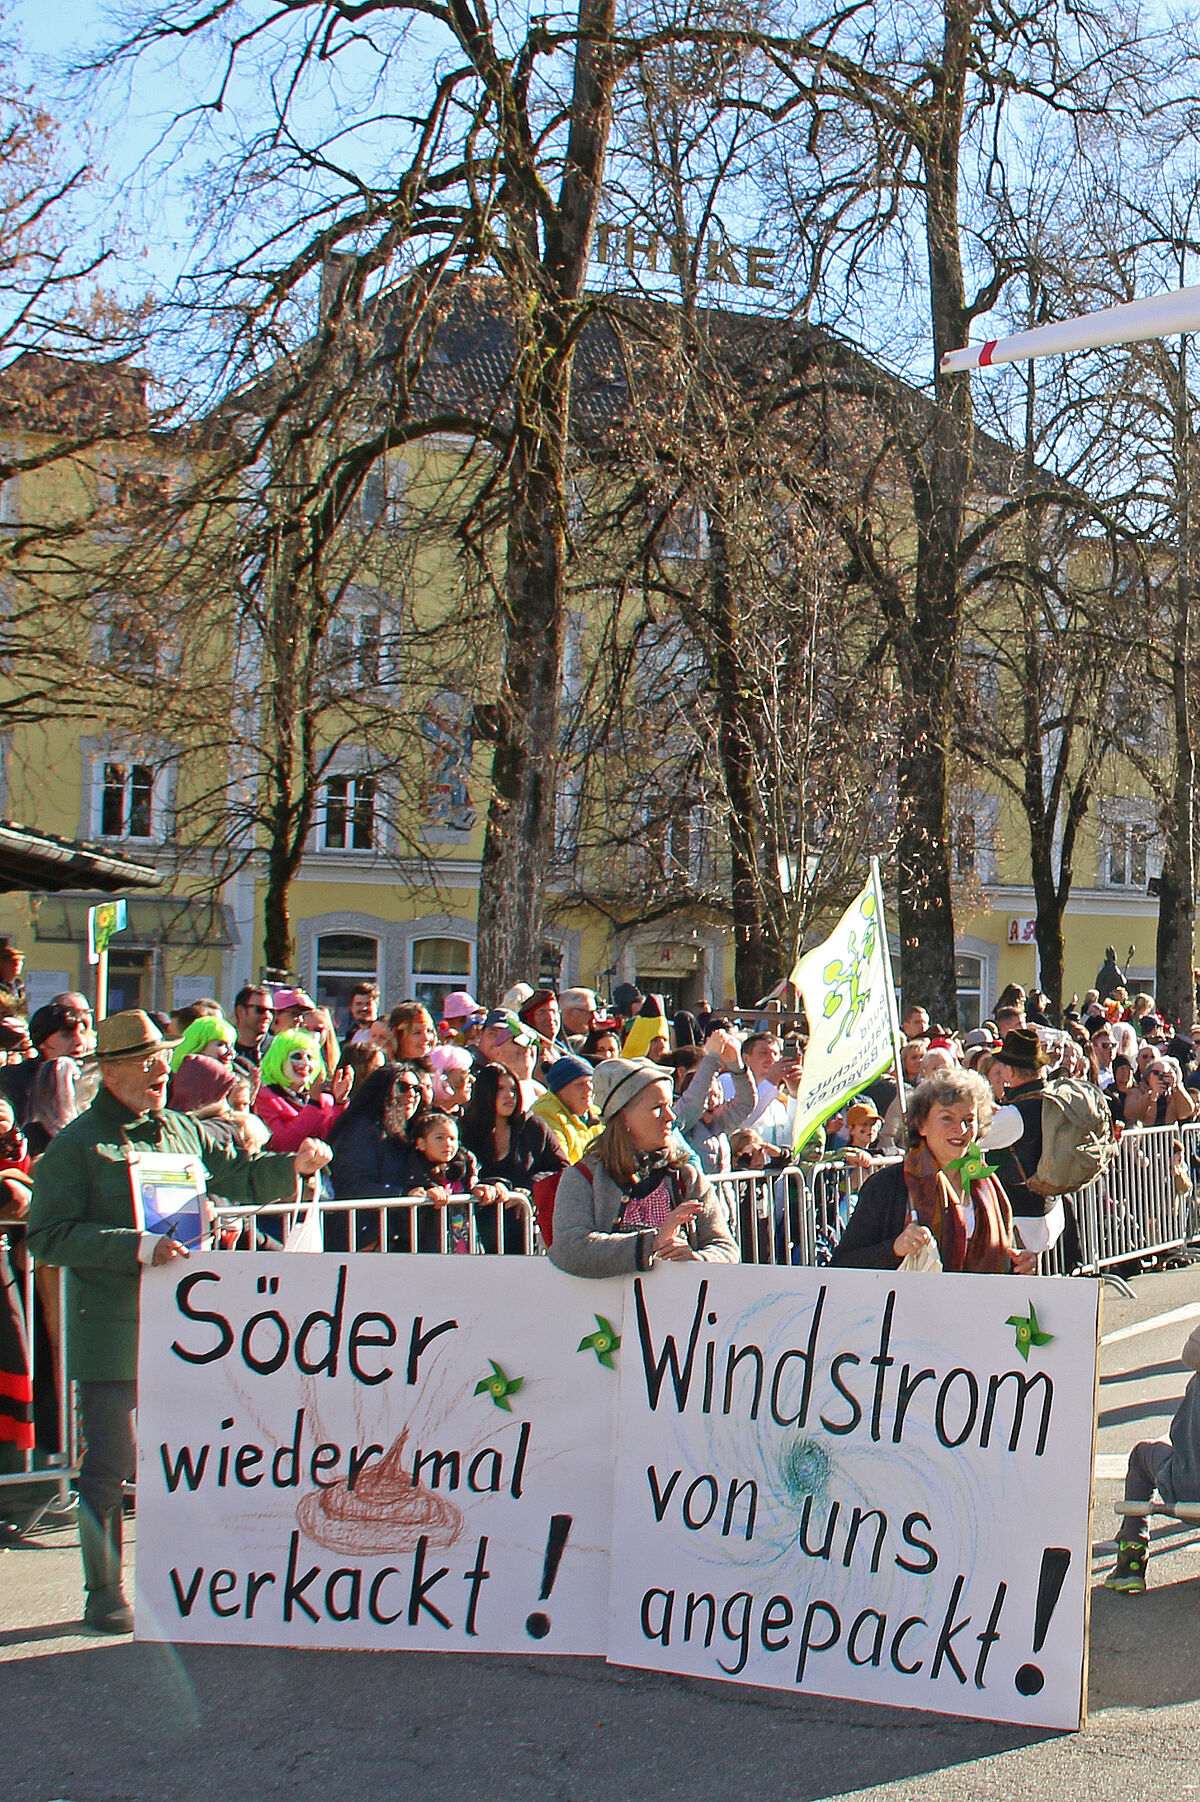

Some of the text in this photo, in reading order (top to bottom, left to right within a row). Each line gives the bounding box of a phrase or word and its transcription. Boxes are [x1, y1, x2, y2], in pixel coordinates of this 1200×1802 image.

[170, 1265, 459, 1387] Söder
[633, 1277, 1055, 1457] Windstrom
[159, 1407, 532, 1500] wieder mal
[646, 1464, 940, 1576] von uns
[640, 1546, 1072, 1698] angepackt!
